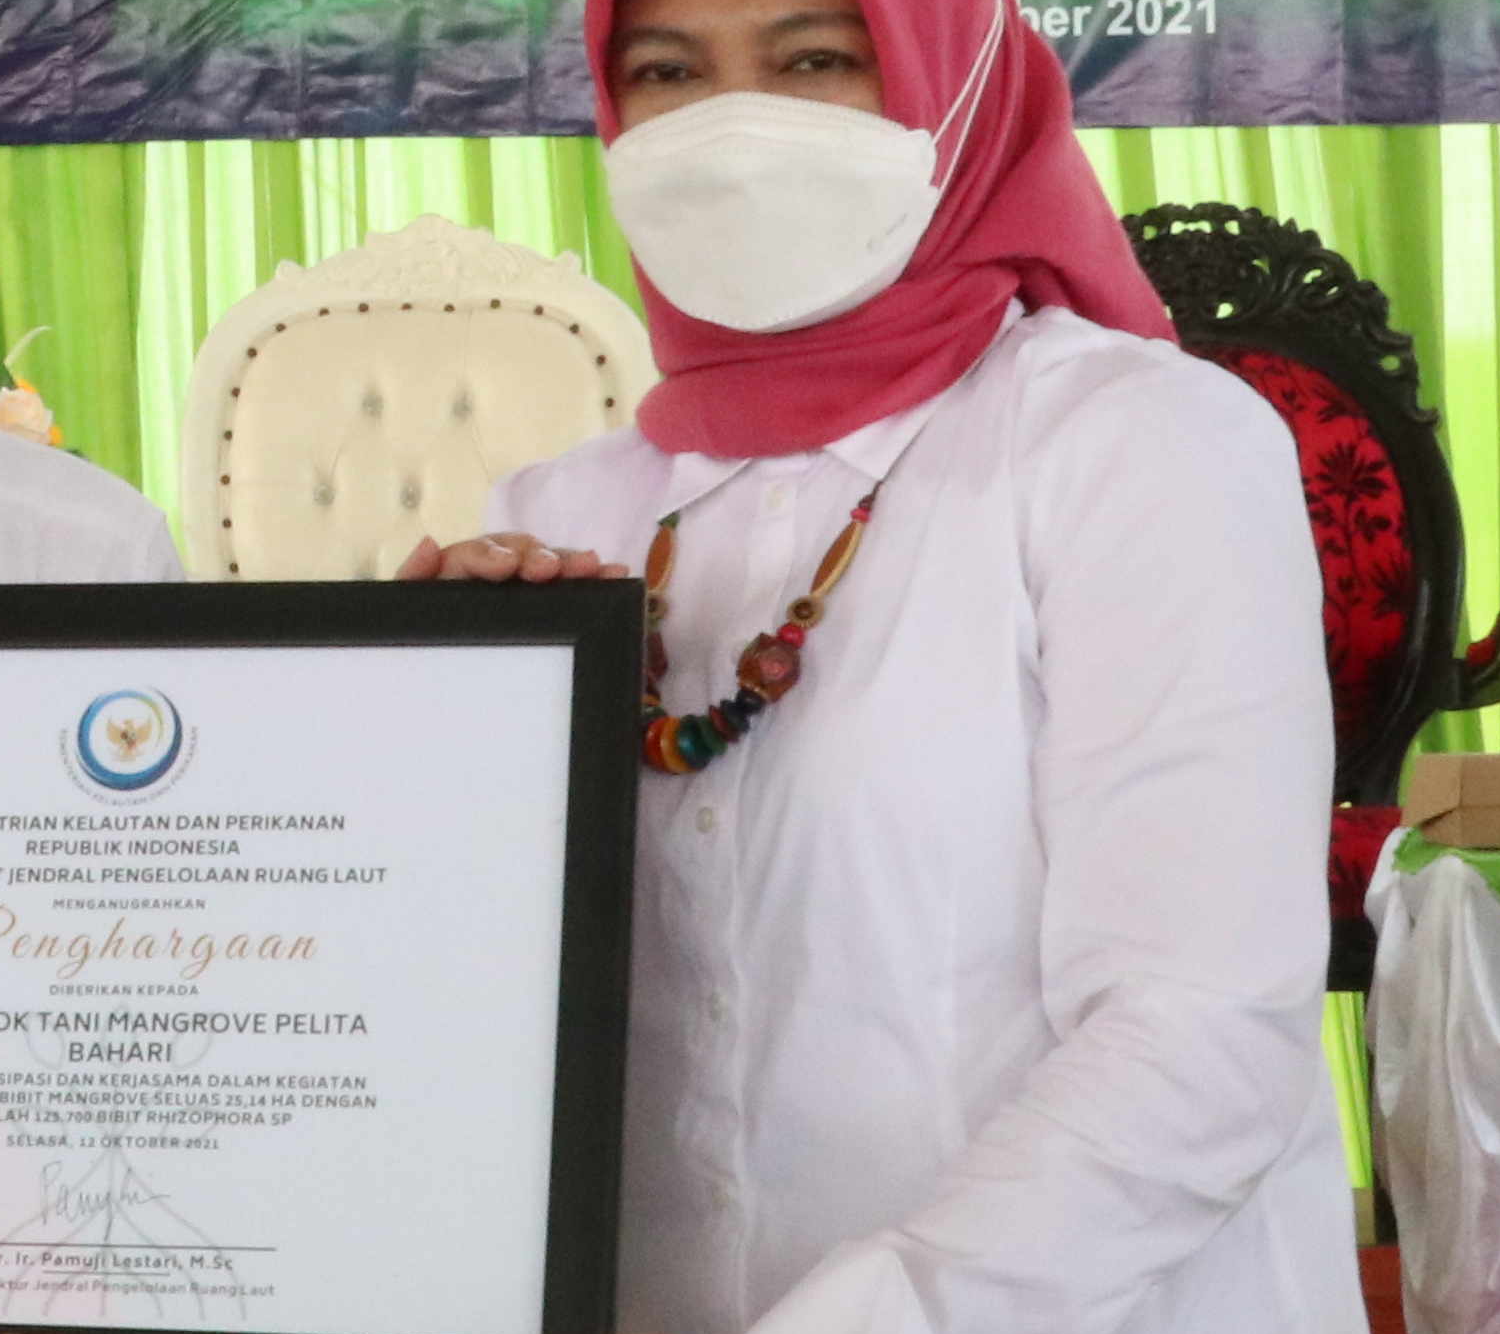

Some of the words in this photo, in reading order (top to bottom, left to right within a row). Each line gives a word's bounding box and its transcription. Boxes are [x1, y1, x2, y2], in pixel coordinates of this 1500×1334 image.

[62, 815, 170, 831] KELAUTAN
[175, 815, 220, 830] DAN
[225, 815, 345, 831] PERIKANAN
[25, 839, 122, 855] REPUBLIK
[127, 838, 240, 855] INDONESIA
[7, 867, 95, 885] JENDRAL
[100, 866, 249, 883] PENGELOLAAN
[254, 867, 328, 883] RUANG
[333, 867, 386, 883] LAUT
[52, 897, 206, 909] MENGANUGRAHKAN
[48, 984, 132, 996] DIBERIKAN
[136, 984, 198, 996] KEPADA
[36, 1010, 99, 1032] TANI
[106, 1011, 266, 1033] MANGROVE
[275, 1012, 366, 1035] PELITA
[68, 1040, 171, 1062] BAHARI
[55, 1072, 94, 1087] DAN
[98, 1072, 201, 1088] KERJASAMA
[206, 1073, 270, 1088] DALAM
[275, 1075, 366, 1090] KEGIATAN
[47, 1090, 148, 1106] MANGROVE
[152, 1090, 220, 1107] SELUAS
[270, 1094, 295, 1107] HA
[300, 1094, 376, 1108] DENGAN
[95, 1109, 142, 1124] BIBIT
[146, 1109, 266, 1125] RHIZOPHORA
[270, 1112, 292, 1126] SP
[6, 1133, 73, 1149] SELASA,
[79, 1136, 95, 1148] 12
[99, 1133, 180, 1148] OKTOBER
[183, 1137, 218, 1150] 2021
